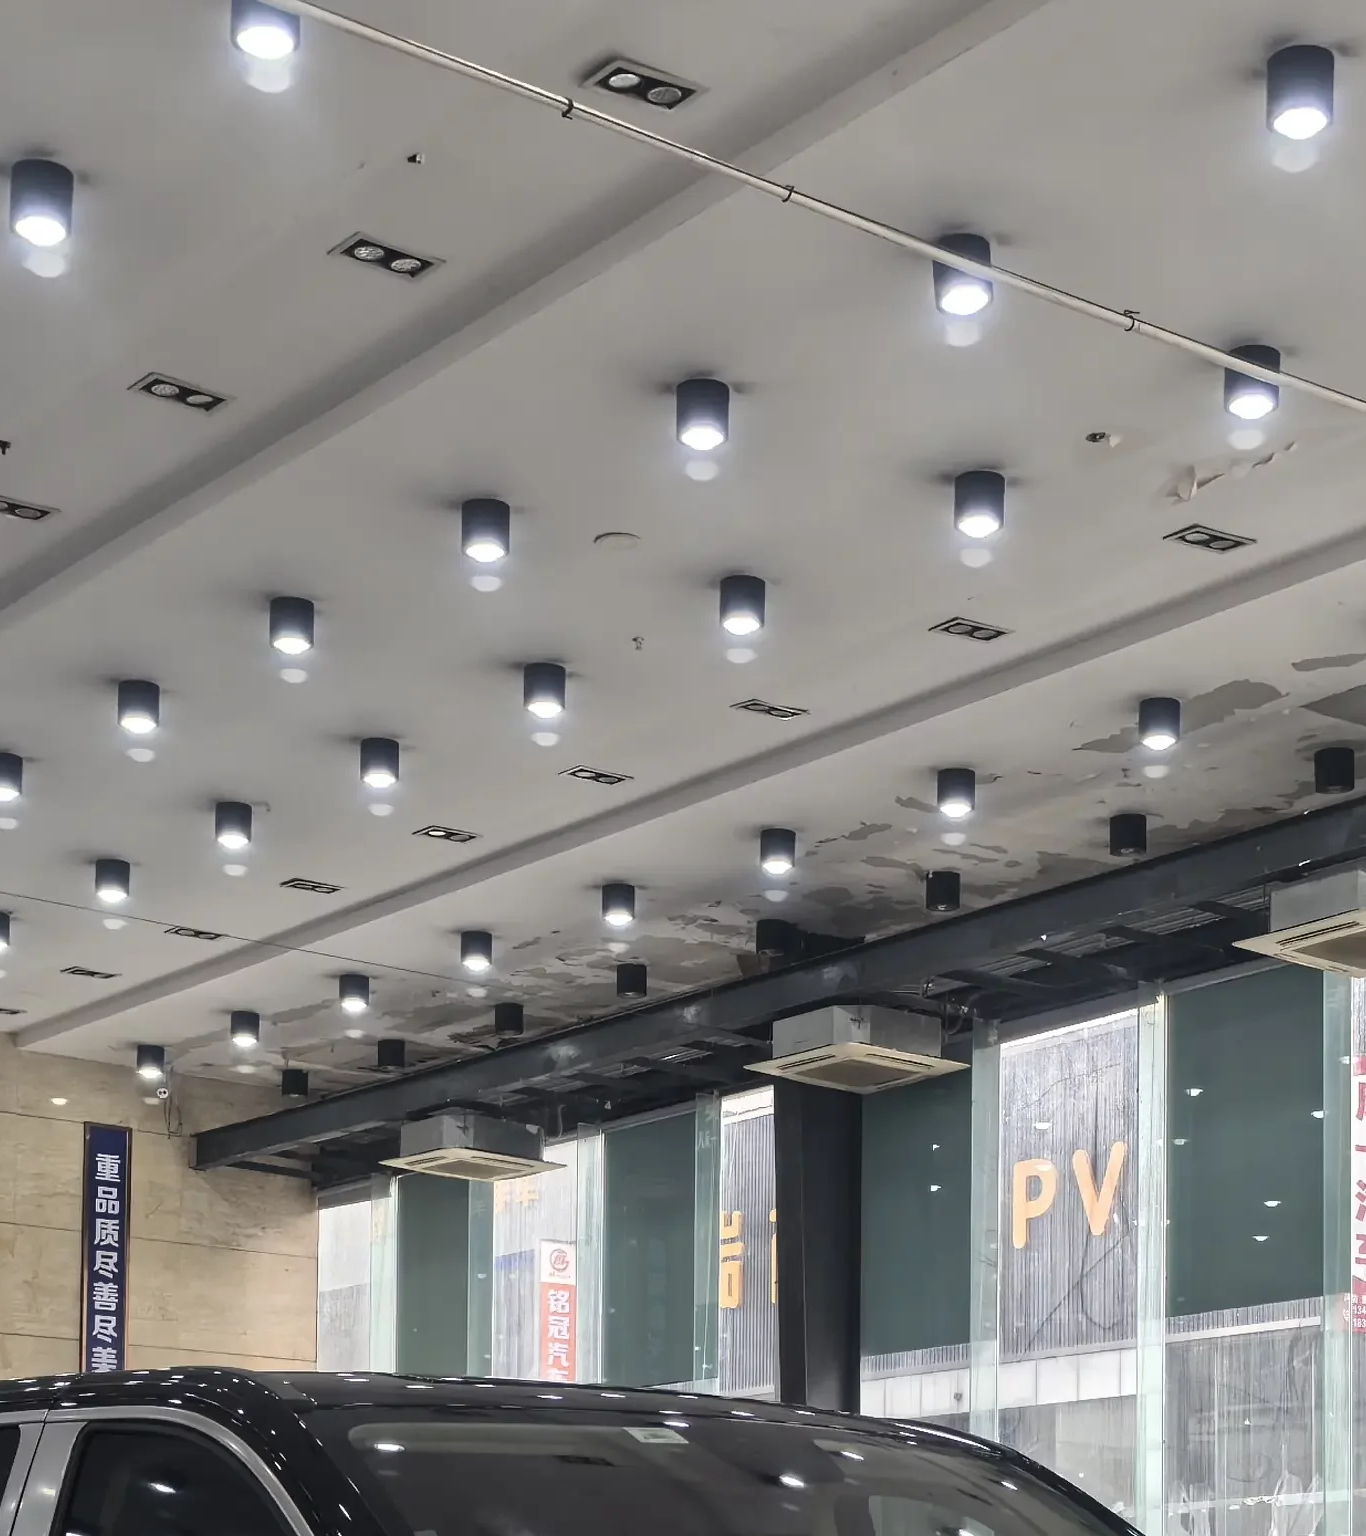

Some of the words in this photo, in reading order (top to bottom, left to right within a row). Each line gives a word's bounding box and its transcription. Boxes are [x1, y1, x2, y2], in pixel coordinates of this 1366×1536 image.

[91, 1153, 122, 1374] 重品质尽善尽美
